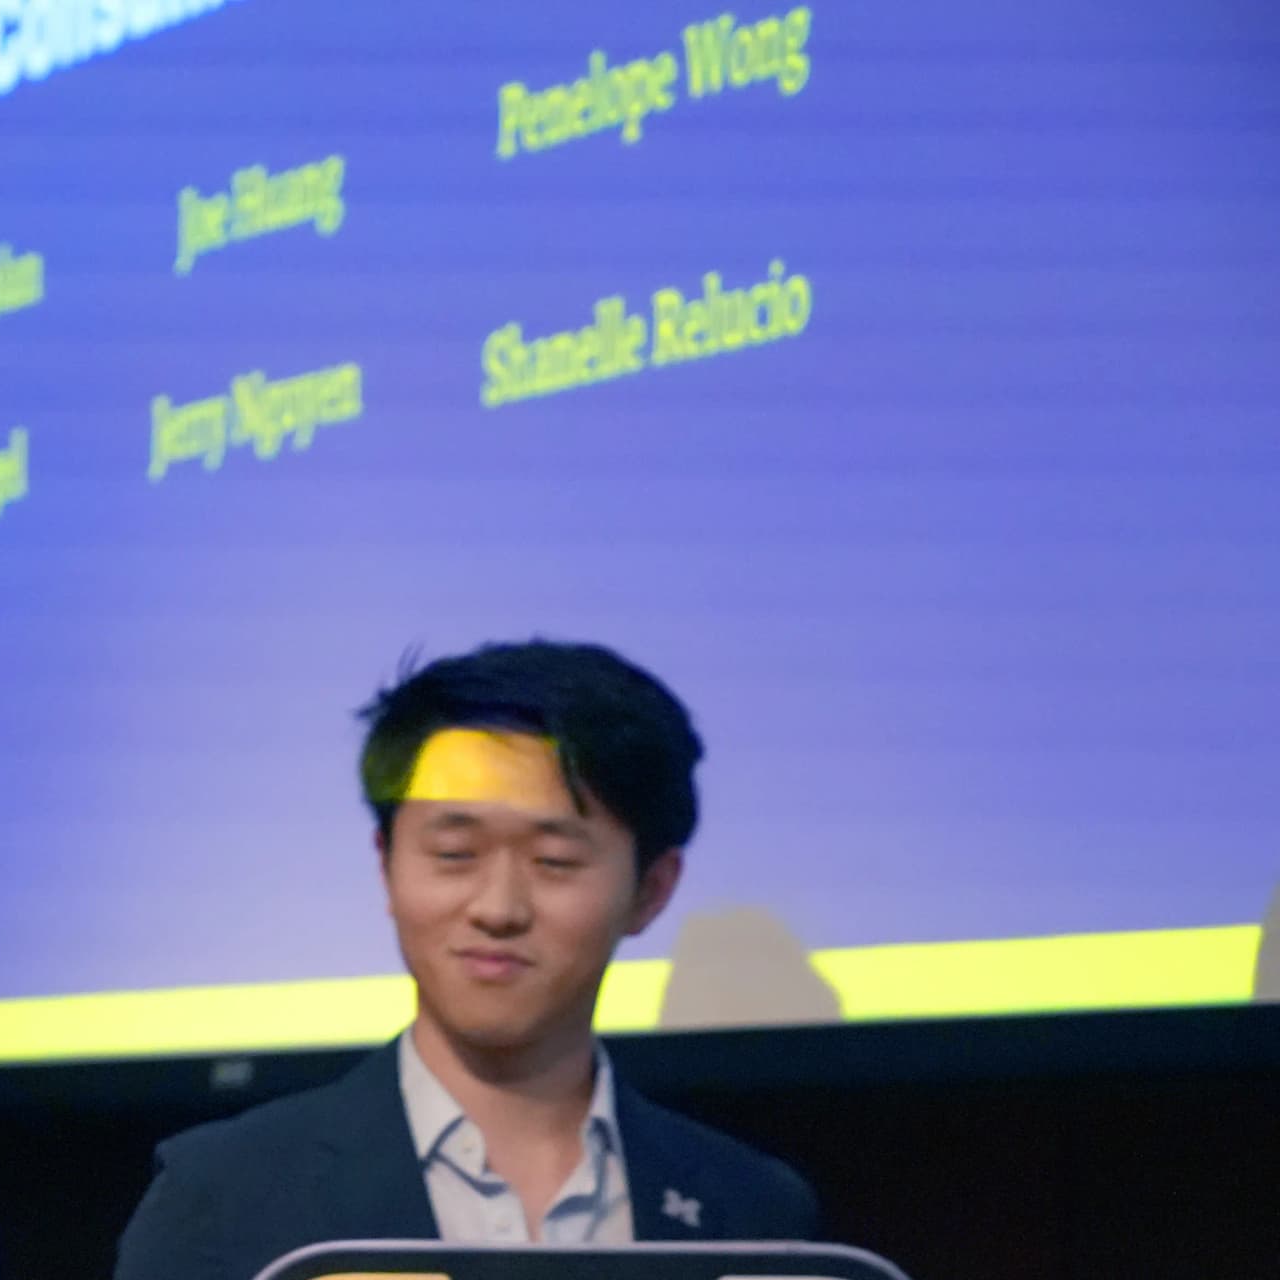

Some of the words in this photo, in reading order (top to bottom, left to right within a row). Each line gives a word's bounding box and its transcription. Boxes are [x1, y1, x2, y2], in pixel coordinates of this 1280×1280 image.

[496, 50, 678, 159] Penelope
[682, 7, 812, 95] Wong
[173, 186, 228, 276] Joe
[480, 296, 648, 406] Shanelle
[652, 259, 812, 365] Relucio
[230, 362, 362, 459] Nguyen
